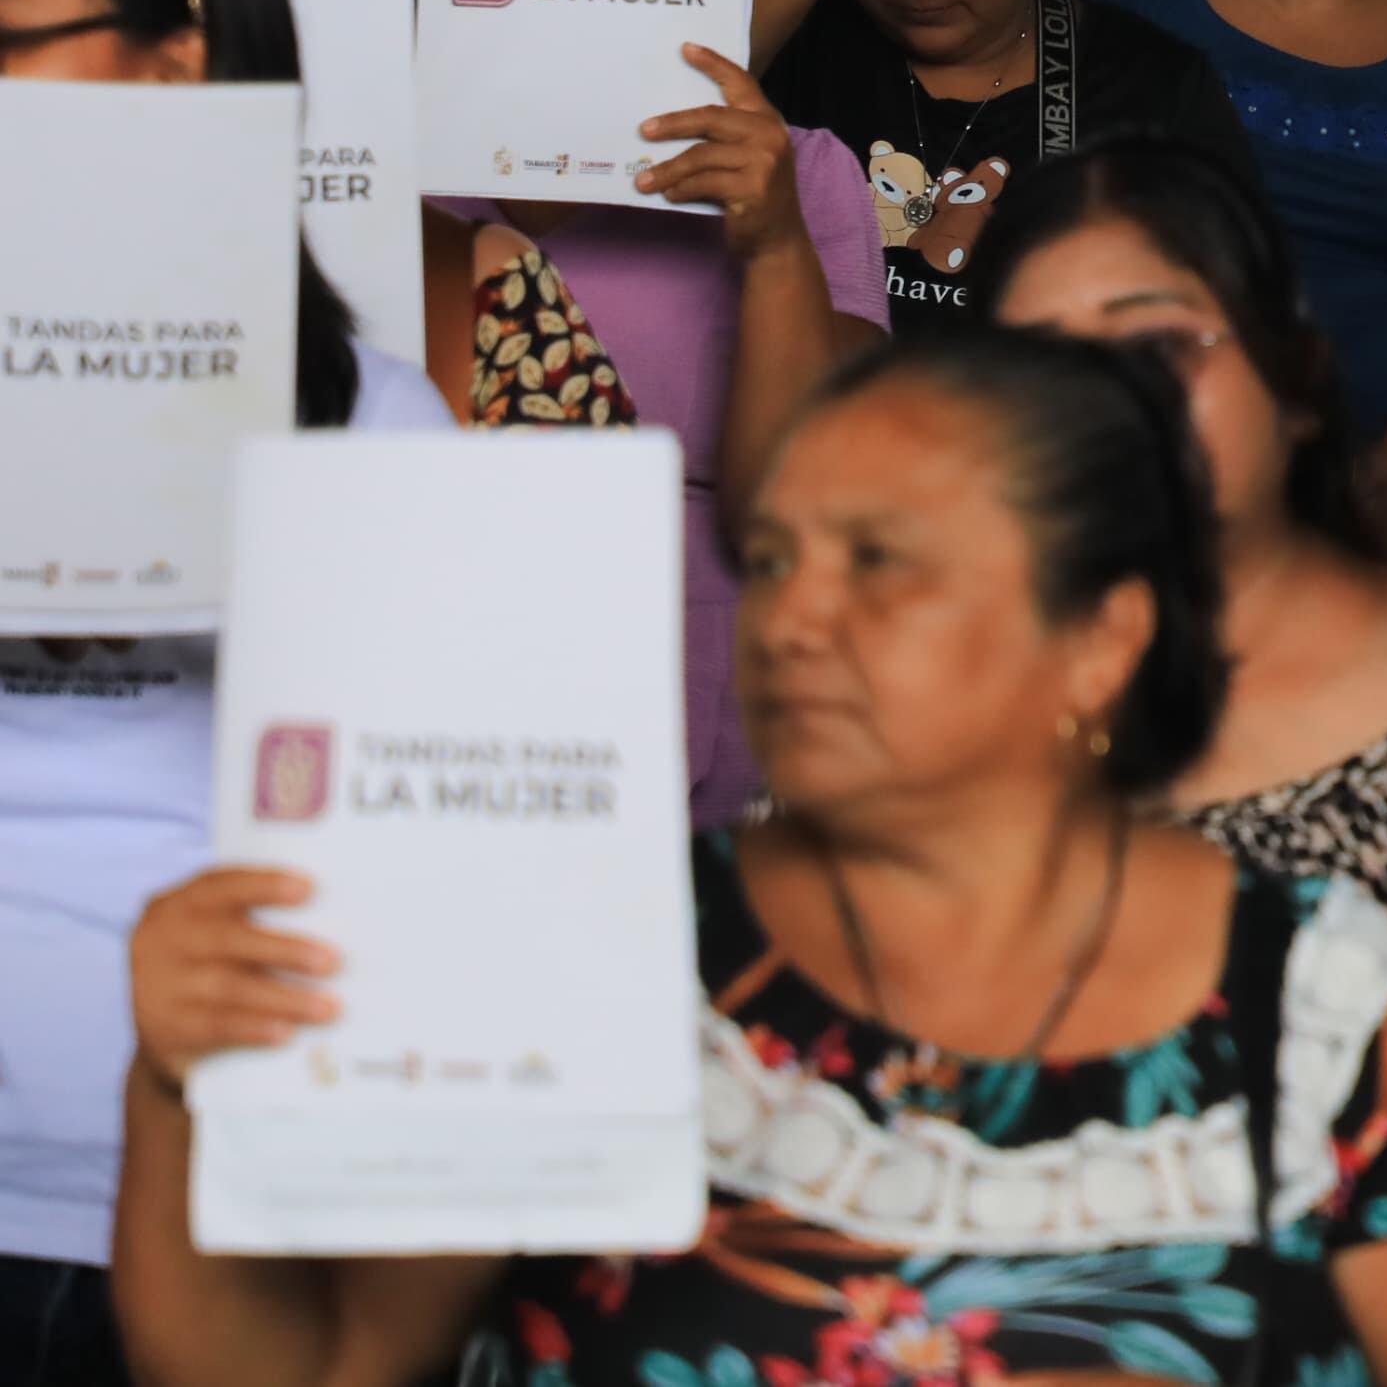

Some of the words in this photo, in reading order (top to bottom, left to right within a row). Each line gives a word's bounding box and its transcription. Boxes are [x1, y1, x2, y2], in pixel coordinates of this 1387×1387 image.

[1044, 82, 1070, 154] IMBA
[300, 146, 376, 167] PARA
[298, 174, 372, 203] JER
[886, 265, 968, 307] have
[7, 316, 145, 343] TANDAS
[153, 319, 245, 343] PARA
[3, 347, 62, 378] LA
[77, 350, 240, 381] MUJER
[350, 772, 418, 815] LA
[428, 774, 620, 817] MUJER
